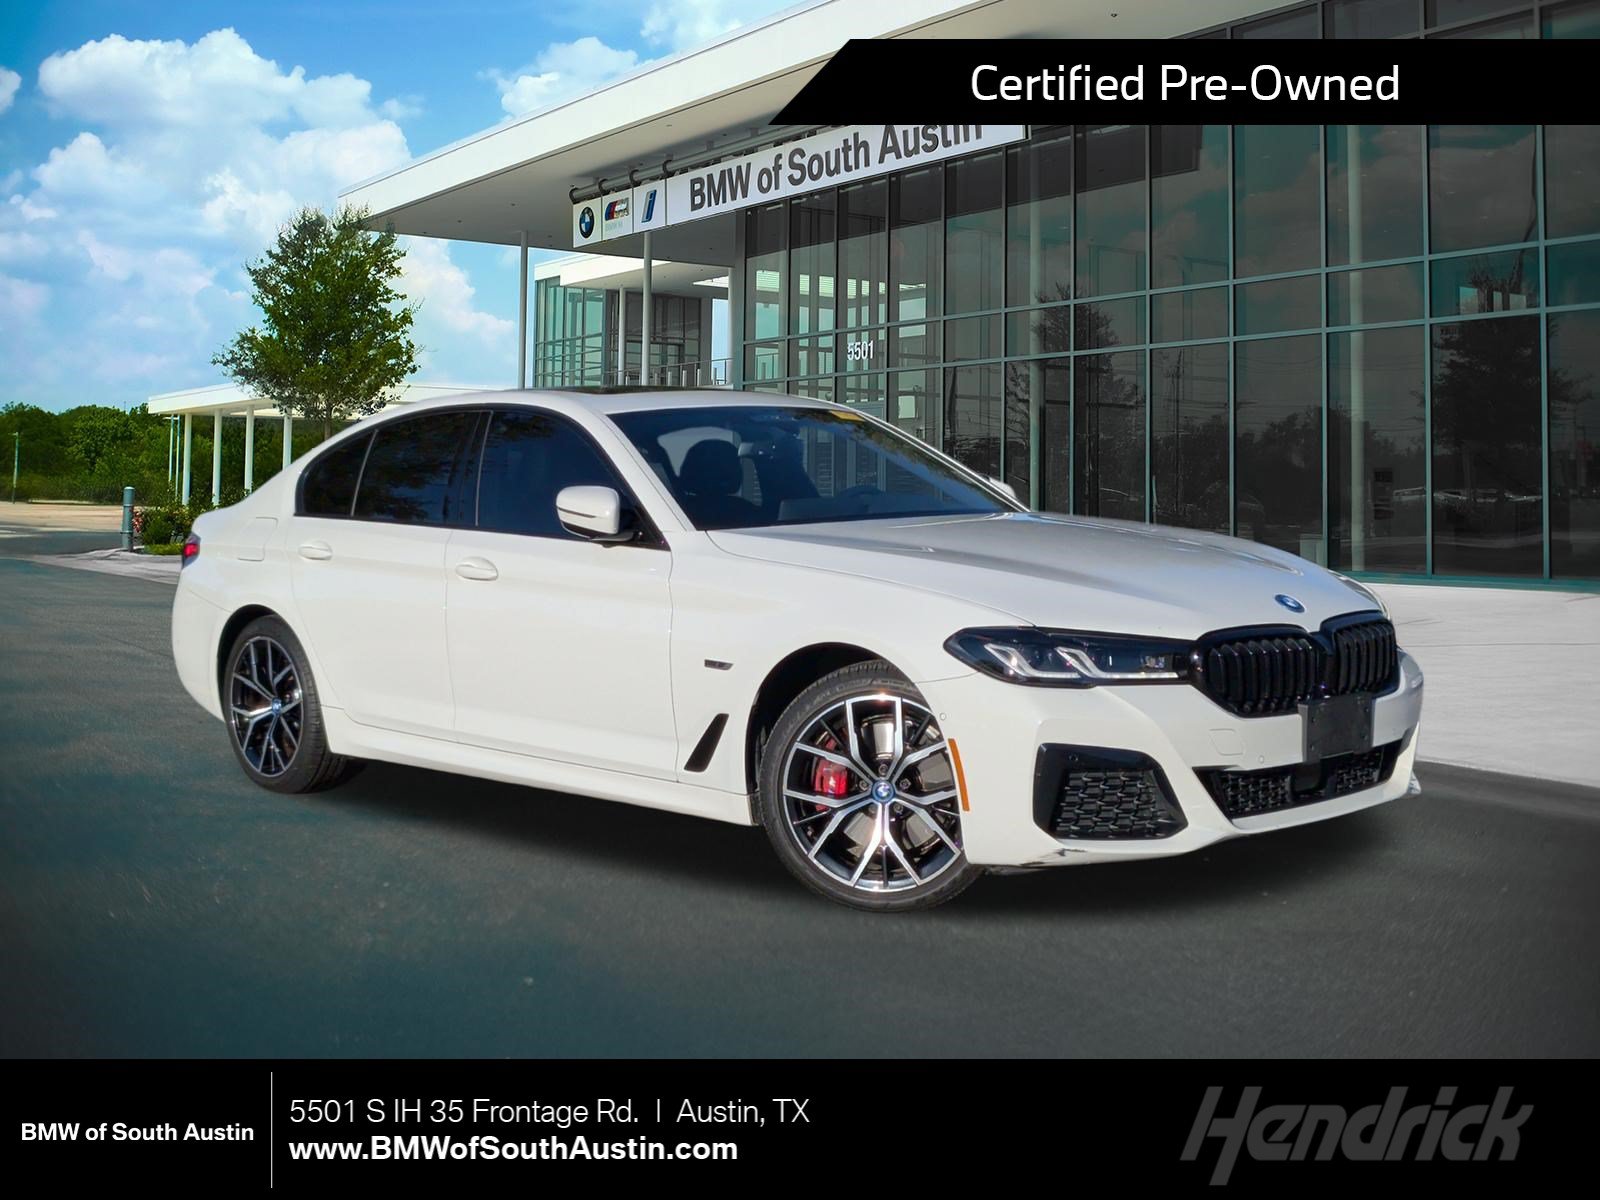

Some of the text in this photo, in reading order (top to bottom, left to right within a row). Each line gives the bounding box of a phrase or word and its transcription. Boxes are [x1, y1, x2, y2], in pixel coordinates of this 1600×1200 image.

[689, 162, 752, 212] BMW
[757, 153, 783, 194] of
[787, 131, 870, 186] South
[847, 340, 874, 361] 5501
